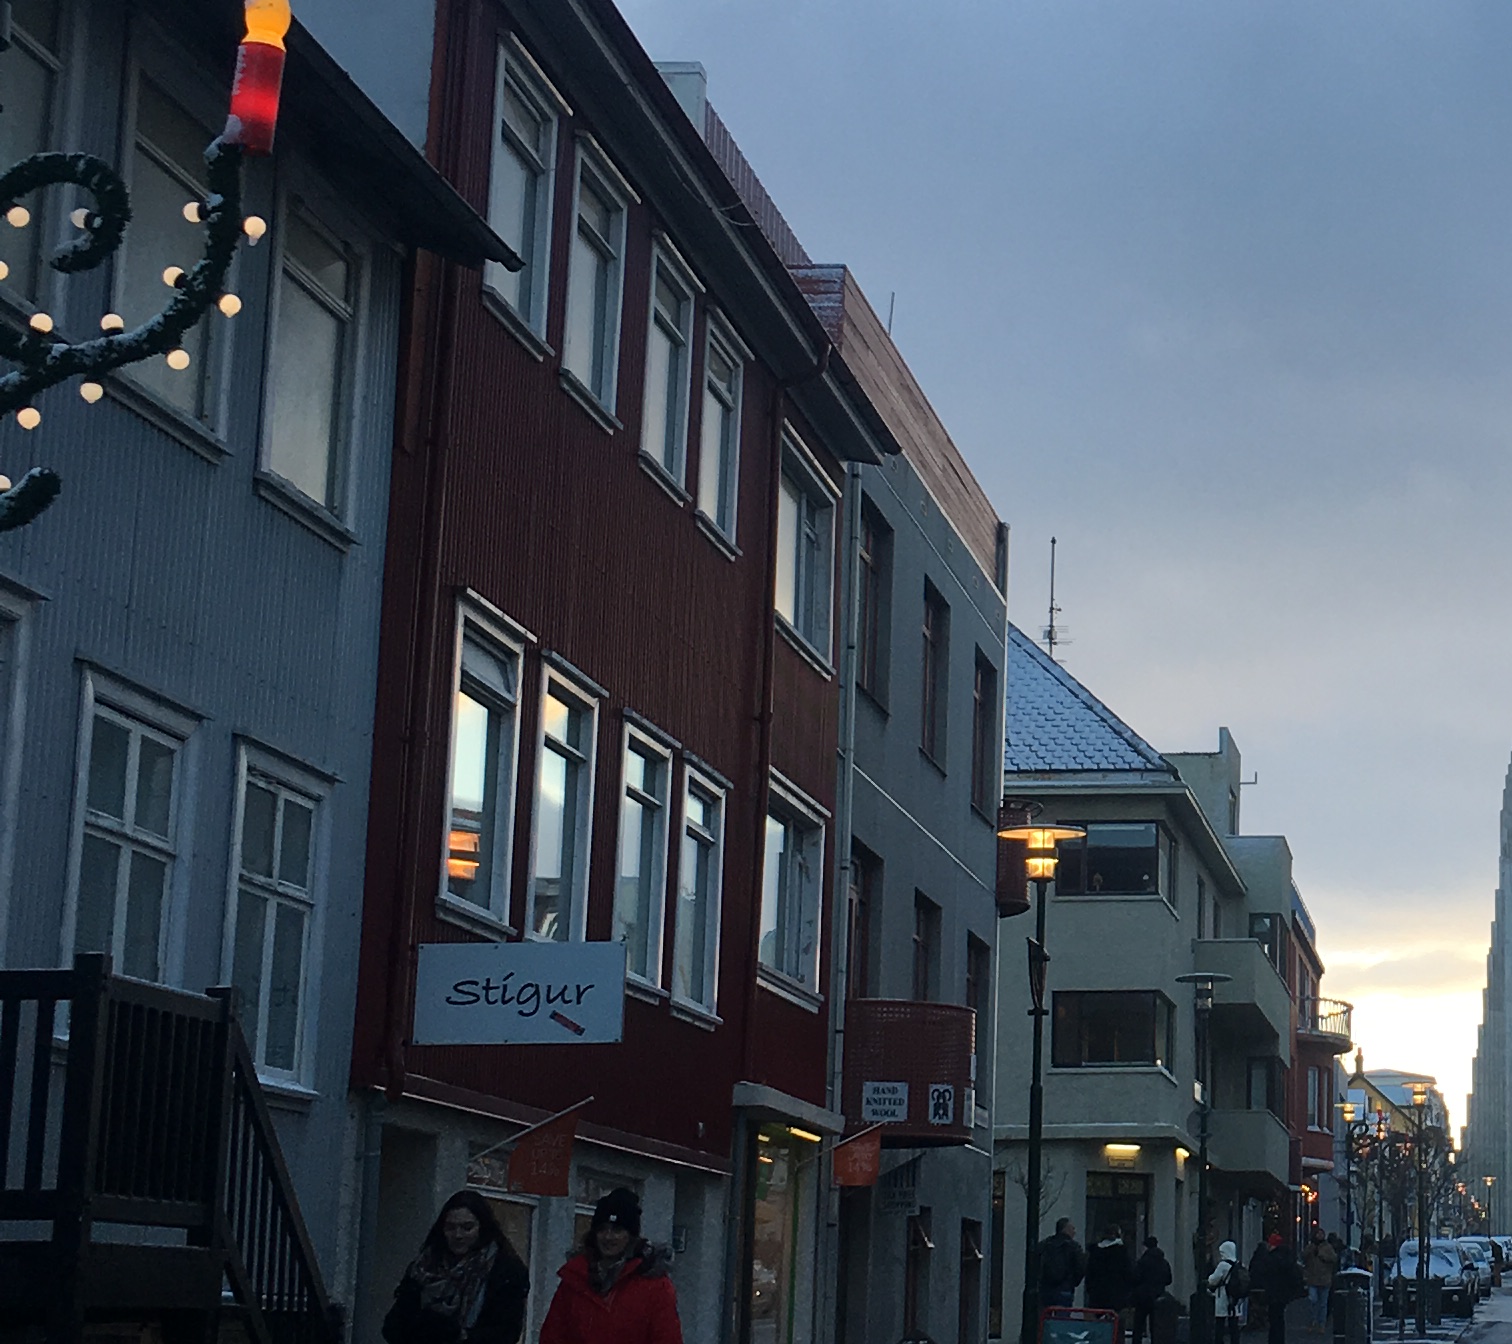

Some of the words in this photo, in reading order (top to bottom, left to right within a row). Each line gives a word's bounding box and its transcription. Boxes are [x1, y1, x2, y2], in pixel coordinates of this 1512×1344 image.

[445, 971, 595, 1017] Stígur
[873, 1086, 899, 1096] HAND
[865, 1097, 905, 1107] KNITTED
[871, 1108, 899, 1118] WOOL
